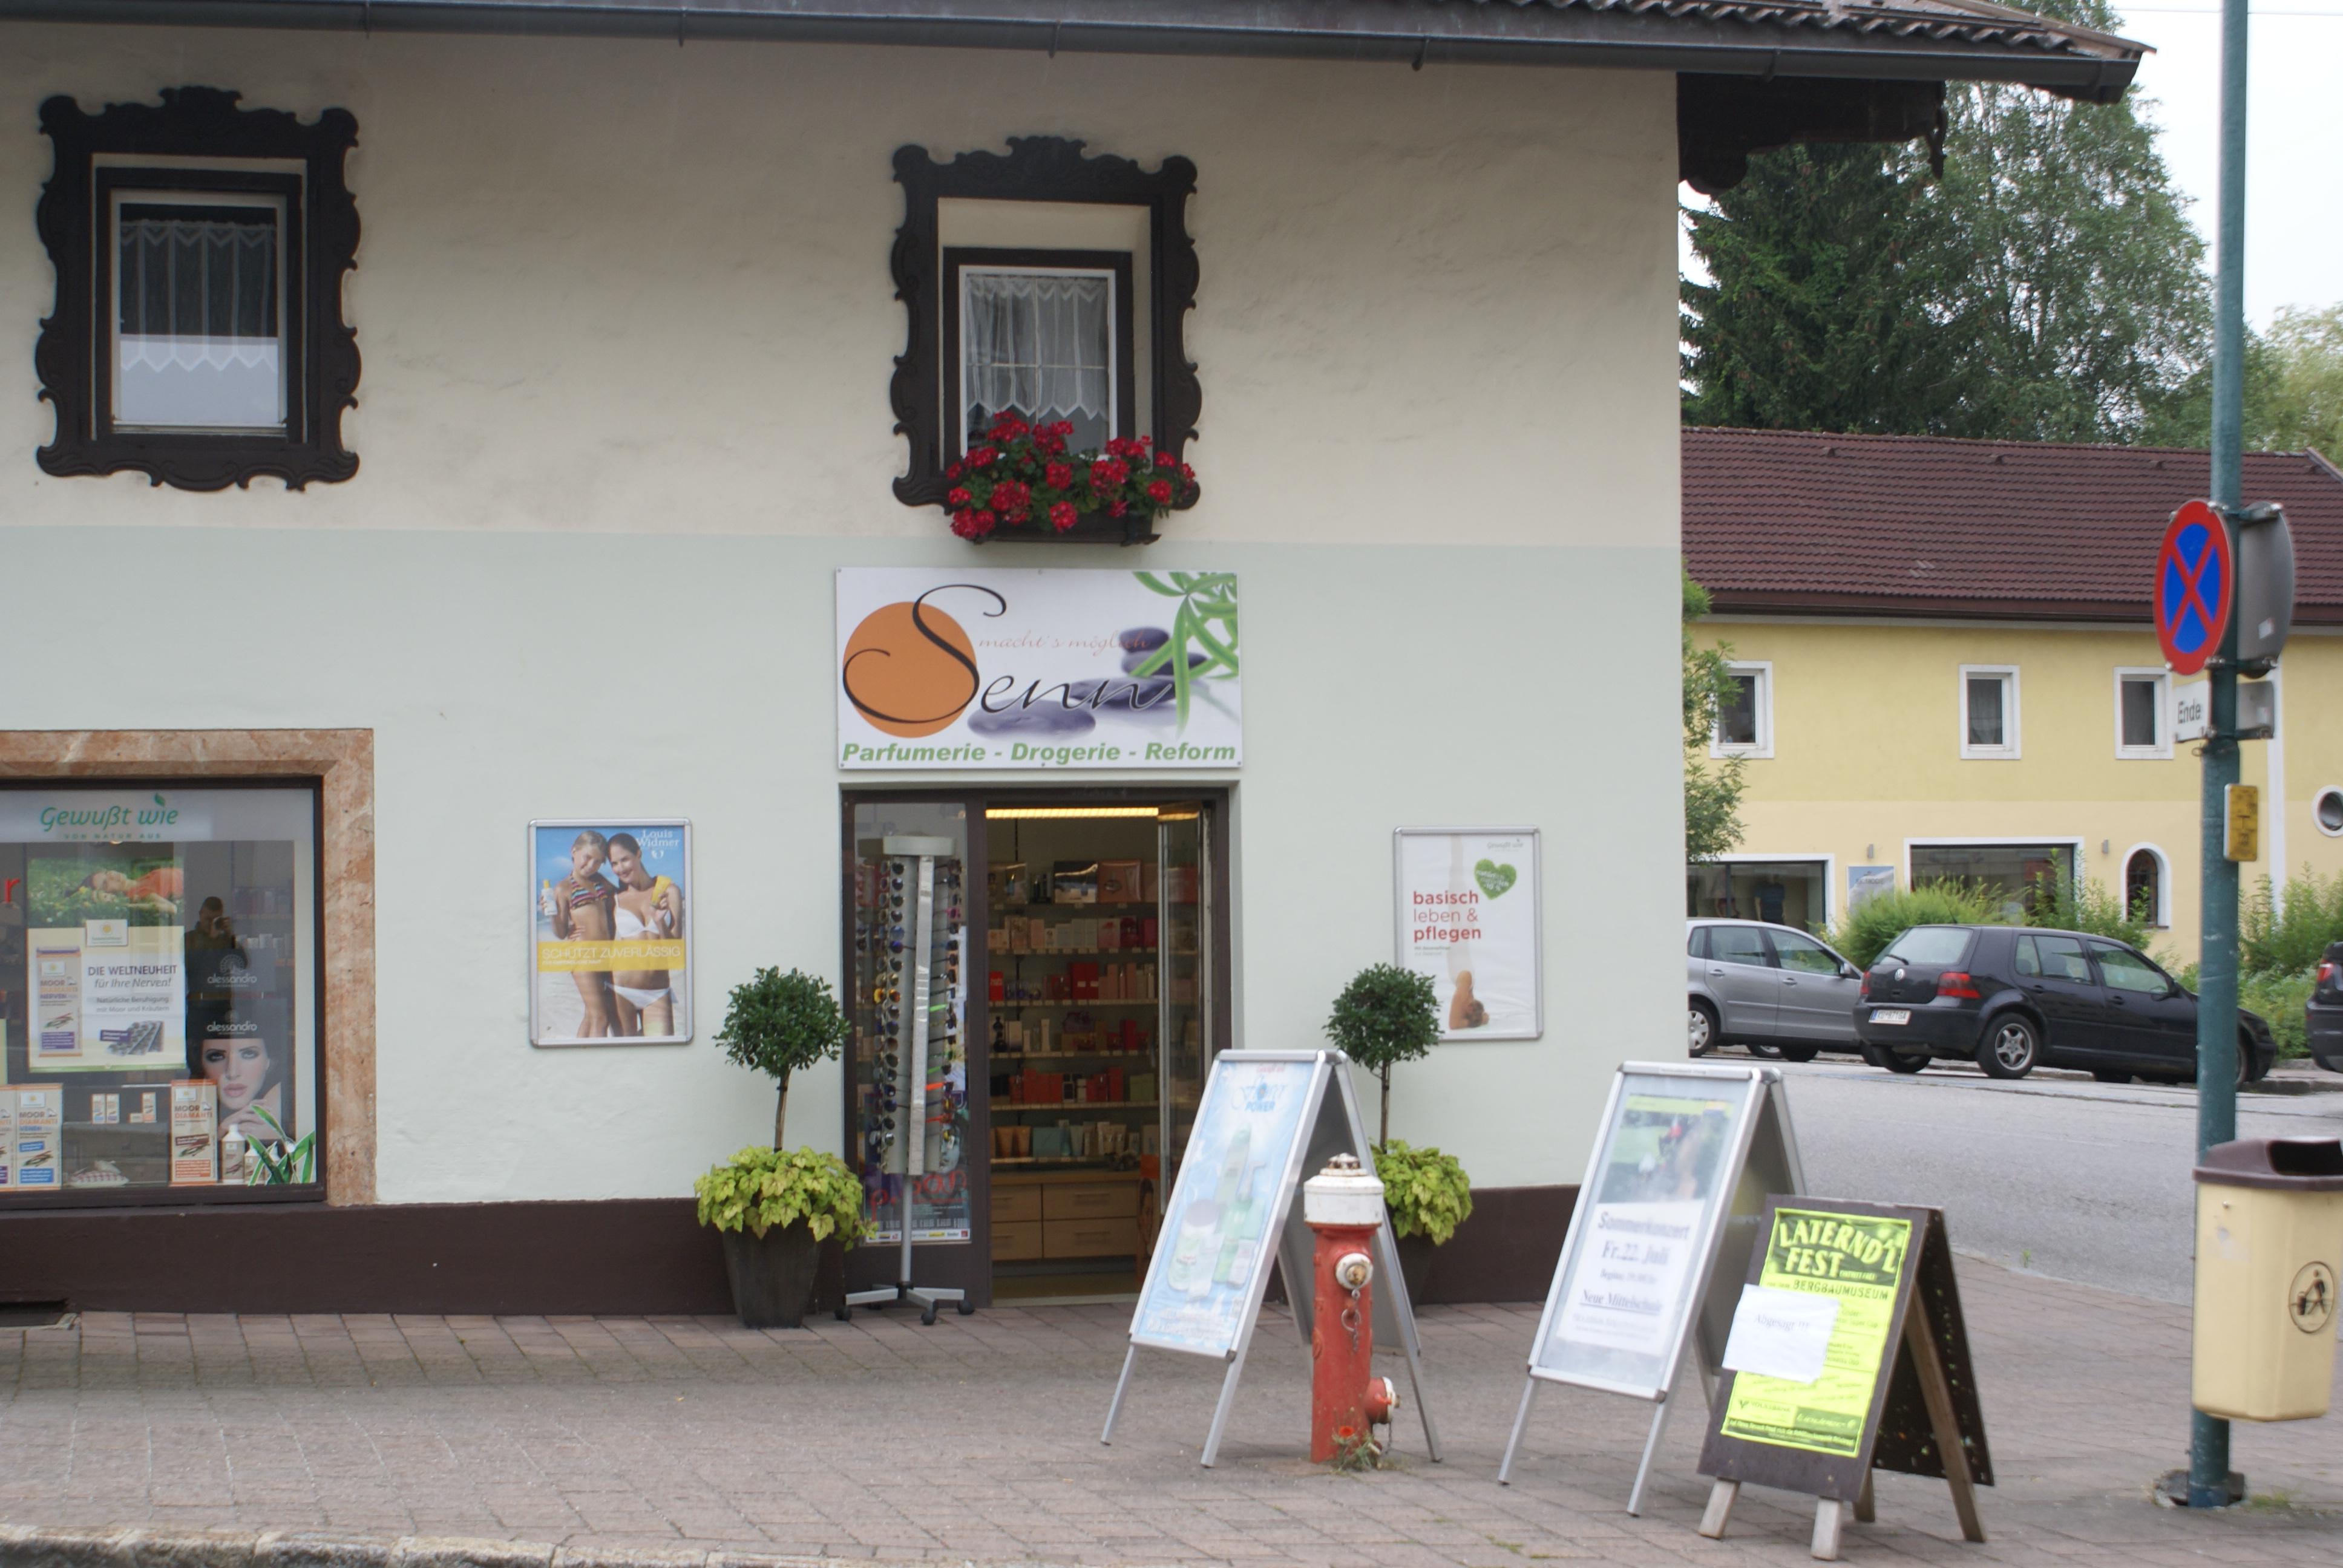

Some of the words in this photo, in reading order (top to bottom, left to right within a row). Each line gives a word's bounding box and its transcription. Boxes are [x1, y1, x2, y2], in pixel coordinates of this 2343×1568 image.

[842, 584, 1173, 724] Senn
[2177, 697, 2201, 725] Ende
[842, 743, 985, 762] Parfumerie
[1011, 743, 1121, 765] Drogerie
[1145, 742, 1236, 760] Reform
[41, 806, 131, 832] Gewußt
[138, 808, 178, 825] wie
[643, 829, 673, 838] Louis
[636, 837, 680, 847] Widmer
[1414, 890, 1478, 905] basisch
[1414, 908, 1460, 923] leben
[1467, 907, 1478, 923] &
[1414, 926, 1481, 943] pflegen
[542, 946, 598, 959] SCHÜTZT
[600, 945, 681, 959] ZUVERLÄSSIG
[88, 967, 105, 976] DIE
[108, 965, 177, 975] WELTNEUHEIT
[94, 978, 109, 988] für
[111, 979, 131, 988] Ihre
[133, 978, 172, 987] Nerven!
[207, 973, 257, 984] alessandro
[207, 1021, 257, 1032] alessandro
[1784, 1247, 1845, 1278] FEST
[1583, 1289, 1604, 1304] Neue
[1792, 1279, 1889, 1301] BERGBAUMUSEUM
[1755, 1314, 1796, 1331] Abgesagt
[1751, 1401, 1791, 1412] VOLKSBANK
